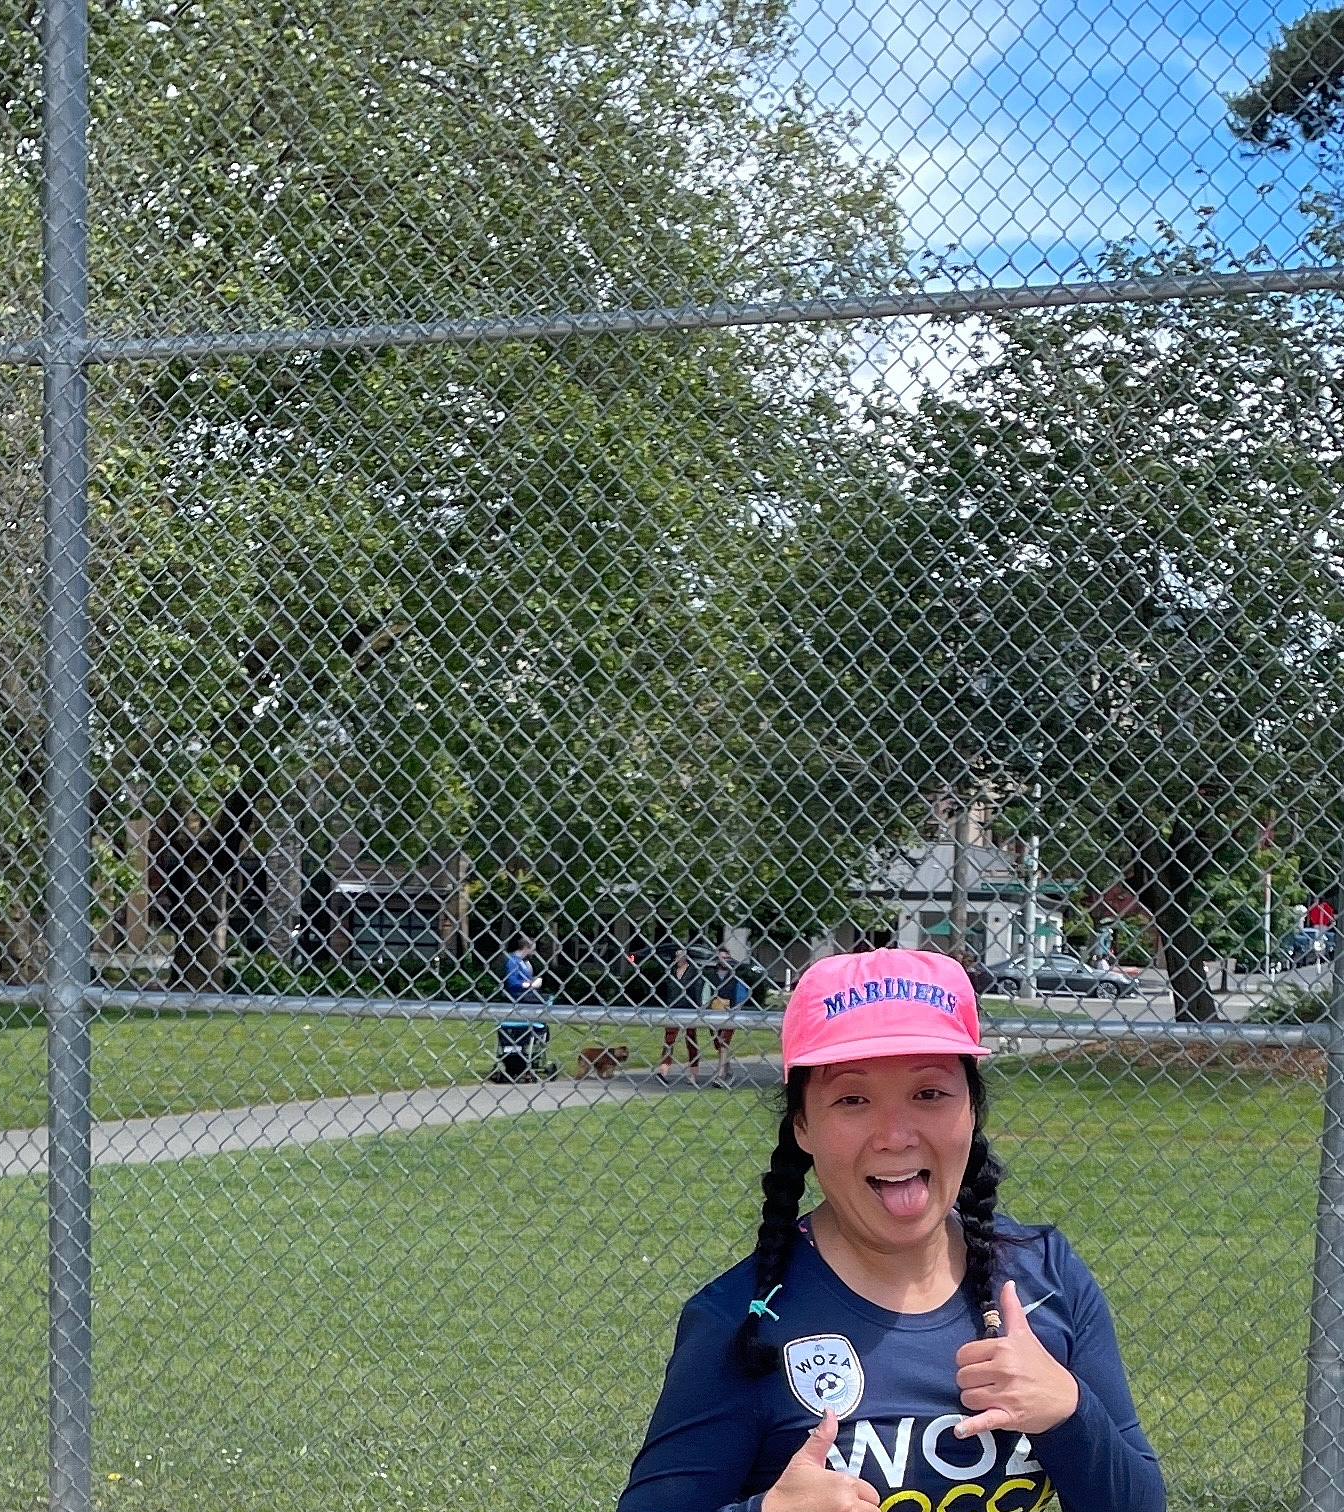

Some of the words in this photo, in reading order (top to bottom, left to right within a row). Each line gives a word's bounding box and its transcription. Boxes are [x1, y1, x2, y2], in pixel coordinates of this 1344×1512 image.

[823, 977, 957, 1020] MARINERS
[795, 1353, 852, 1374] WOZA
[808, 1413, 1044, 1488] WOZ
